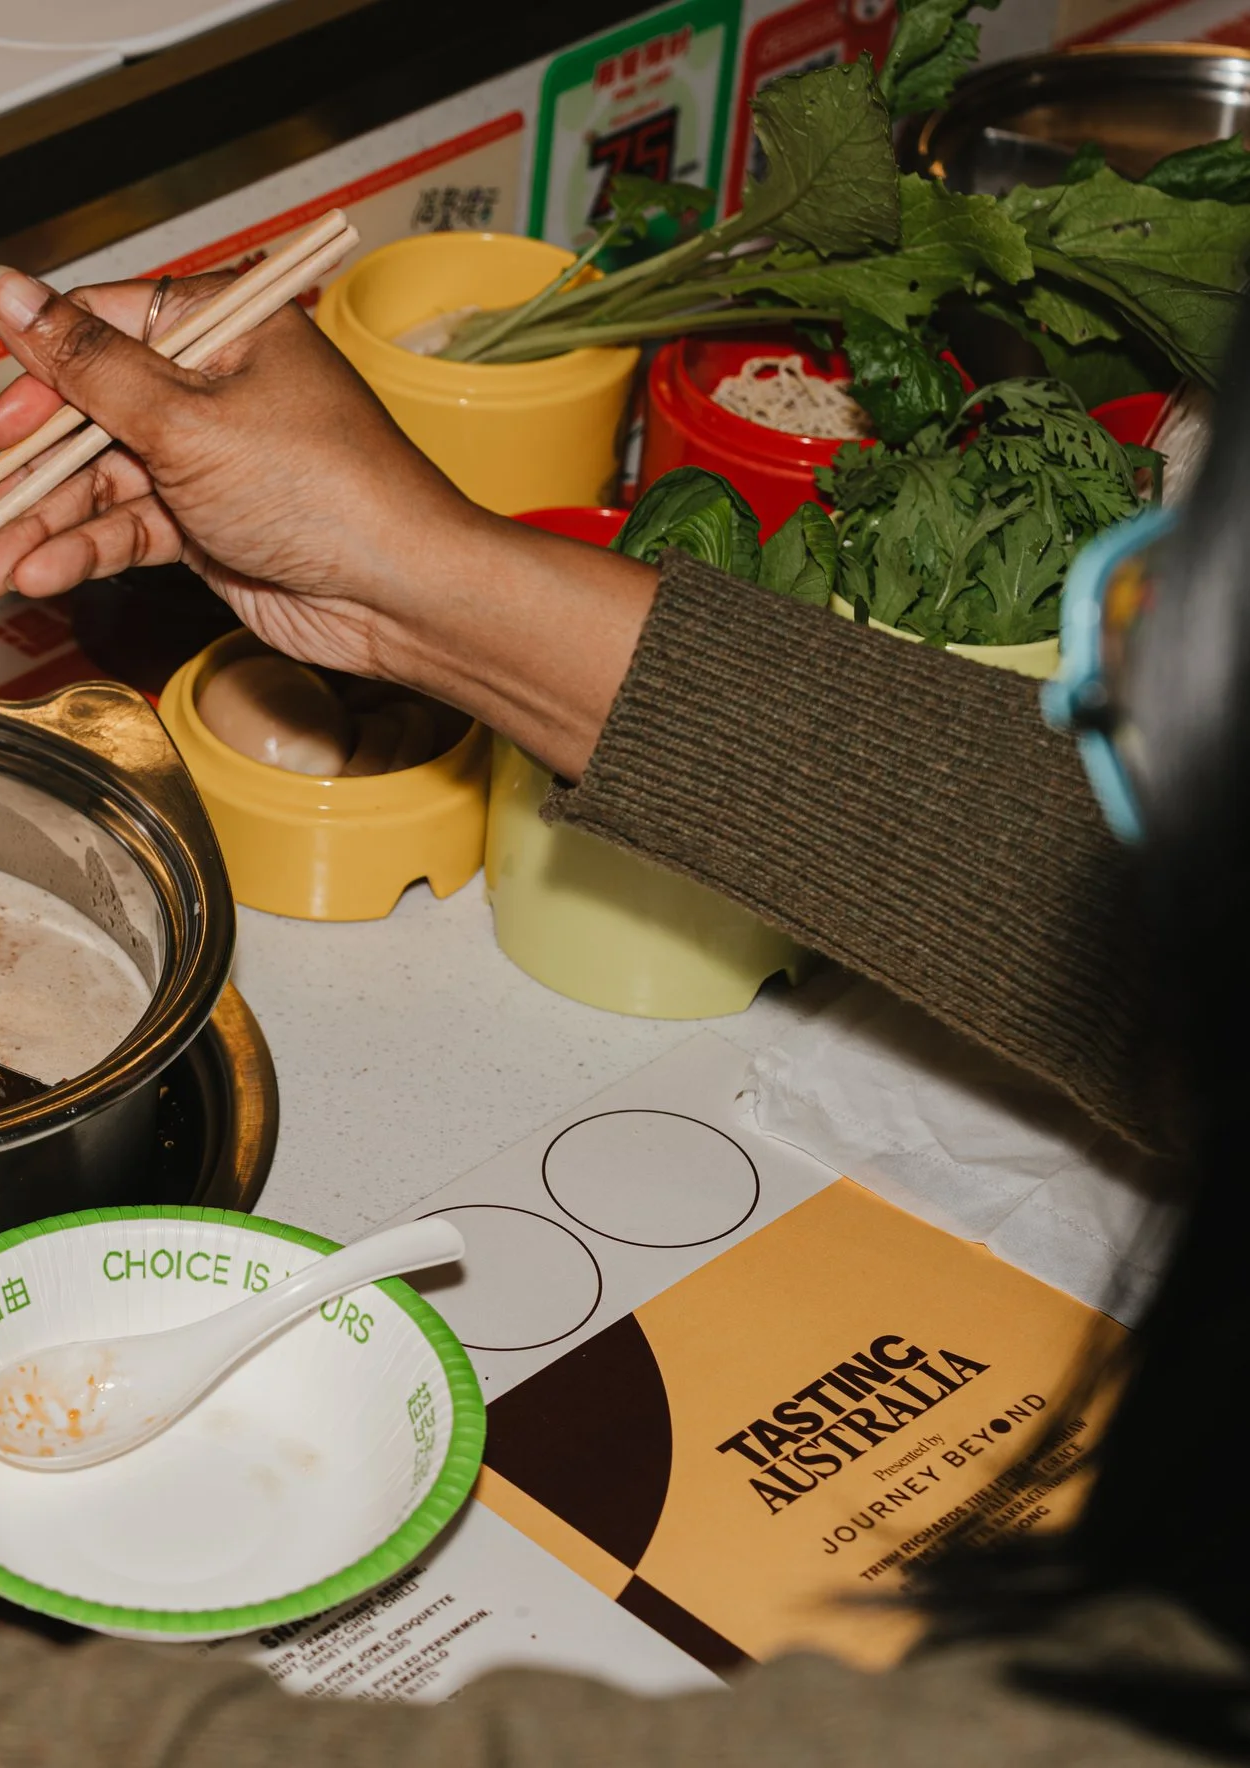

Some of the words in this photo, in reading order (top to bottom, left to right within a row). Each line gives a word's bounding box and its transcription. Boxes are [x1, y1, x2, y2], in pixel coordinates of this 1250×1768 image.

[103, 1249, 232, 1285] CHOICE
[243, 1260, 270, 1293] IS
[715, 1334, 928, 1468] TASTING
[748, 1349, 991, 1515] AUSTRALIA
[872, 1440, 930, 1481] Presented
[926, 1433, 946, 1452] by
[822, 1465, 941, 1554] JOURNEY
[941, 1394, 1047, 1467] BEYOND
[900, 1506, 969, 1554] RICHARDS
[963, 1488, 990, 1511] THE
[382, 1580, 420, 1609] CHILLI
[387, 1593, 456, 1641] CROQUETTE
